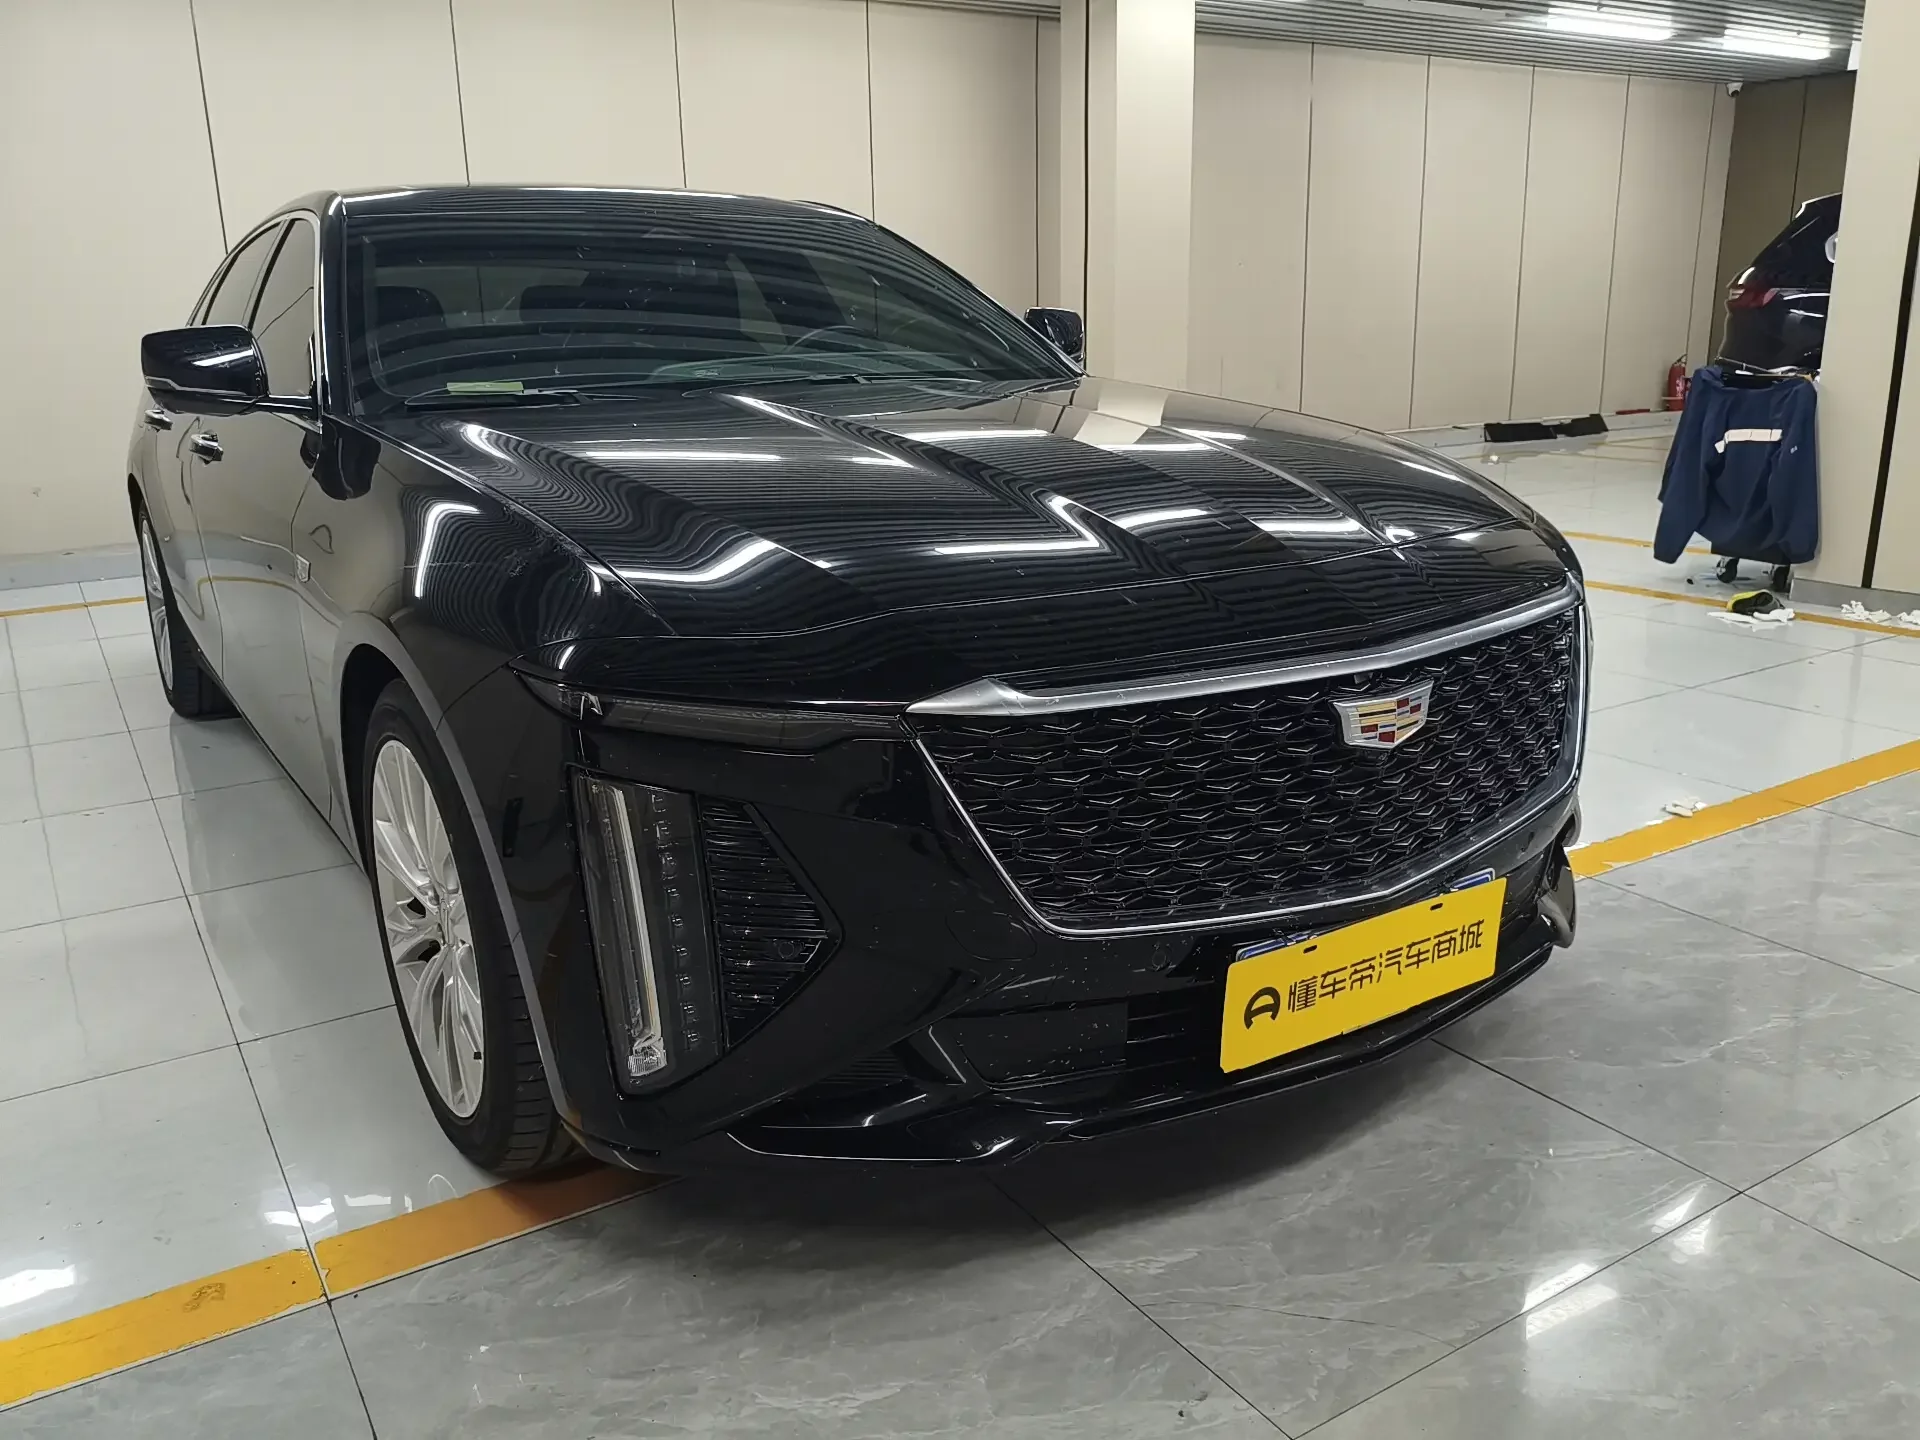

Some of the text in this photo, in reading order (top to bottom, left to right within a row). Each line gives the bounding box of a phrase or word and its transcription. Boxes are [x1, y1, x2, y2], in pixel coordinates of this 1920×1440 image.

[1287, 919, 1485, 1013] 懂车帝汽车商城
